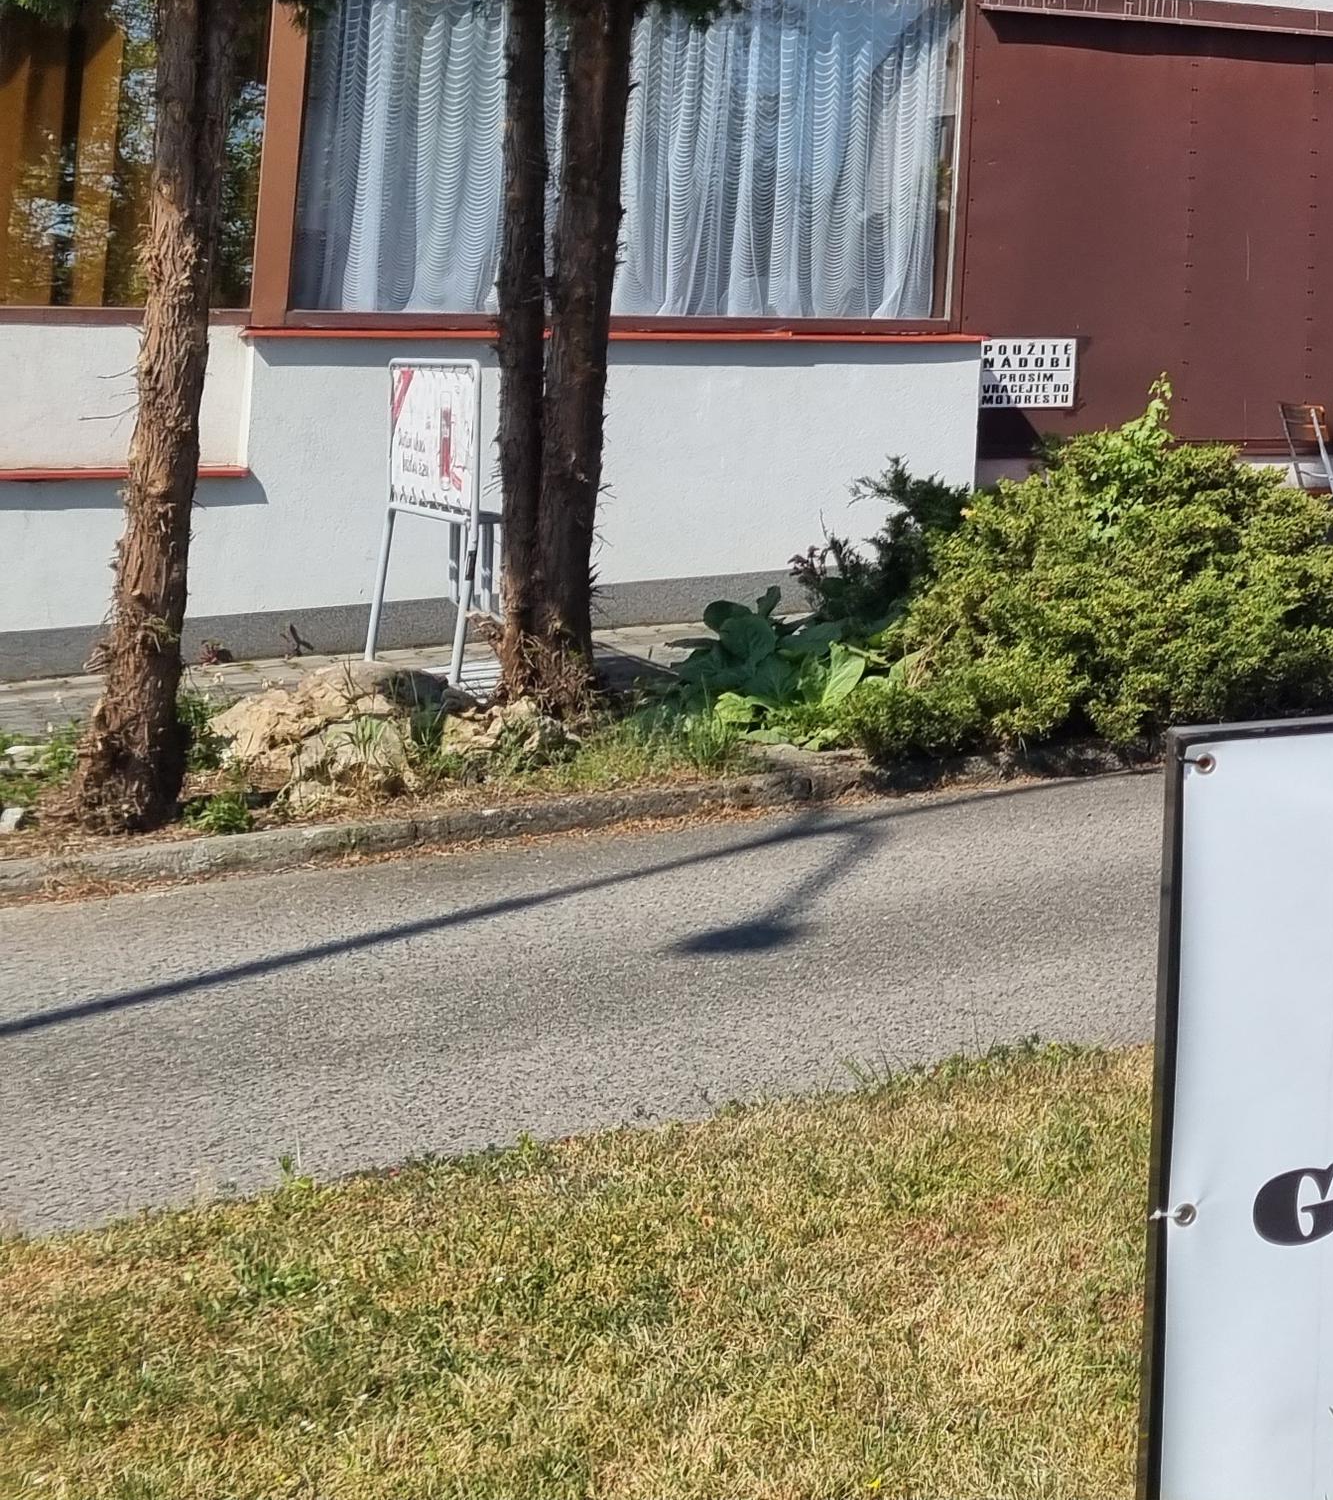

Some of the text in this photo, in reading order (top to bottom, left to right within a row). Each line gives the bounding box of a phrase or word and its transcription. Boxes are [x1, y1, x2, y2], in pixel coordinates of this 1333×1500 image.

[983, 342, 1072, 355] POUŽITÉ
[983, 355, 1071, 368] NÁDOBÍ
[999, 372, 1054, 383] PROSÍM
[982, 384, 1069, 394] VRACEJTE DO
[981, 395, 1069, 405] MOTORESTU
